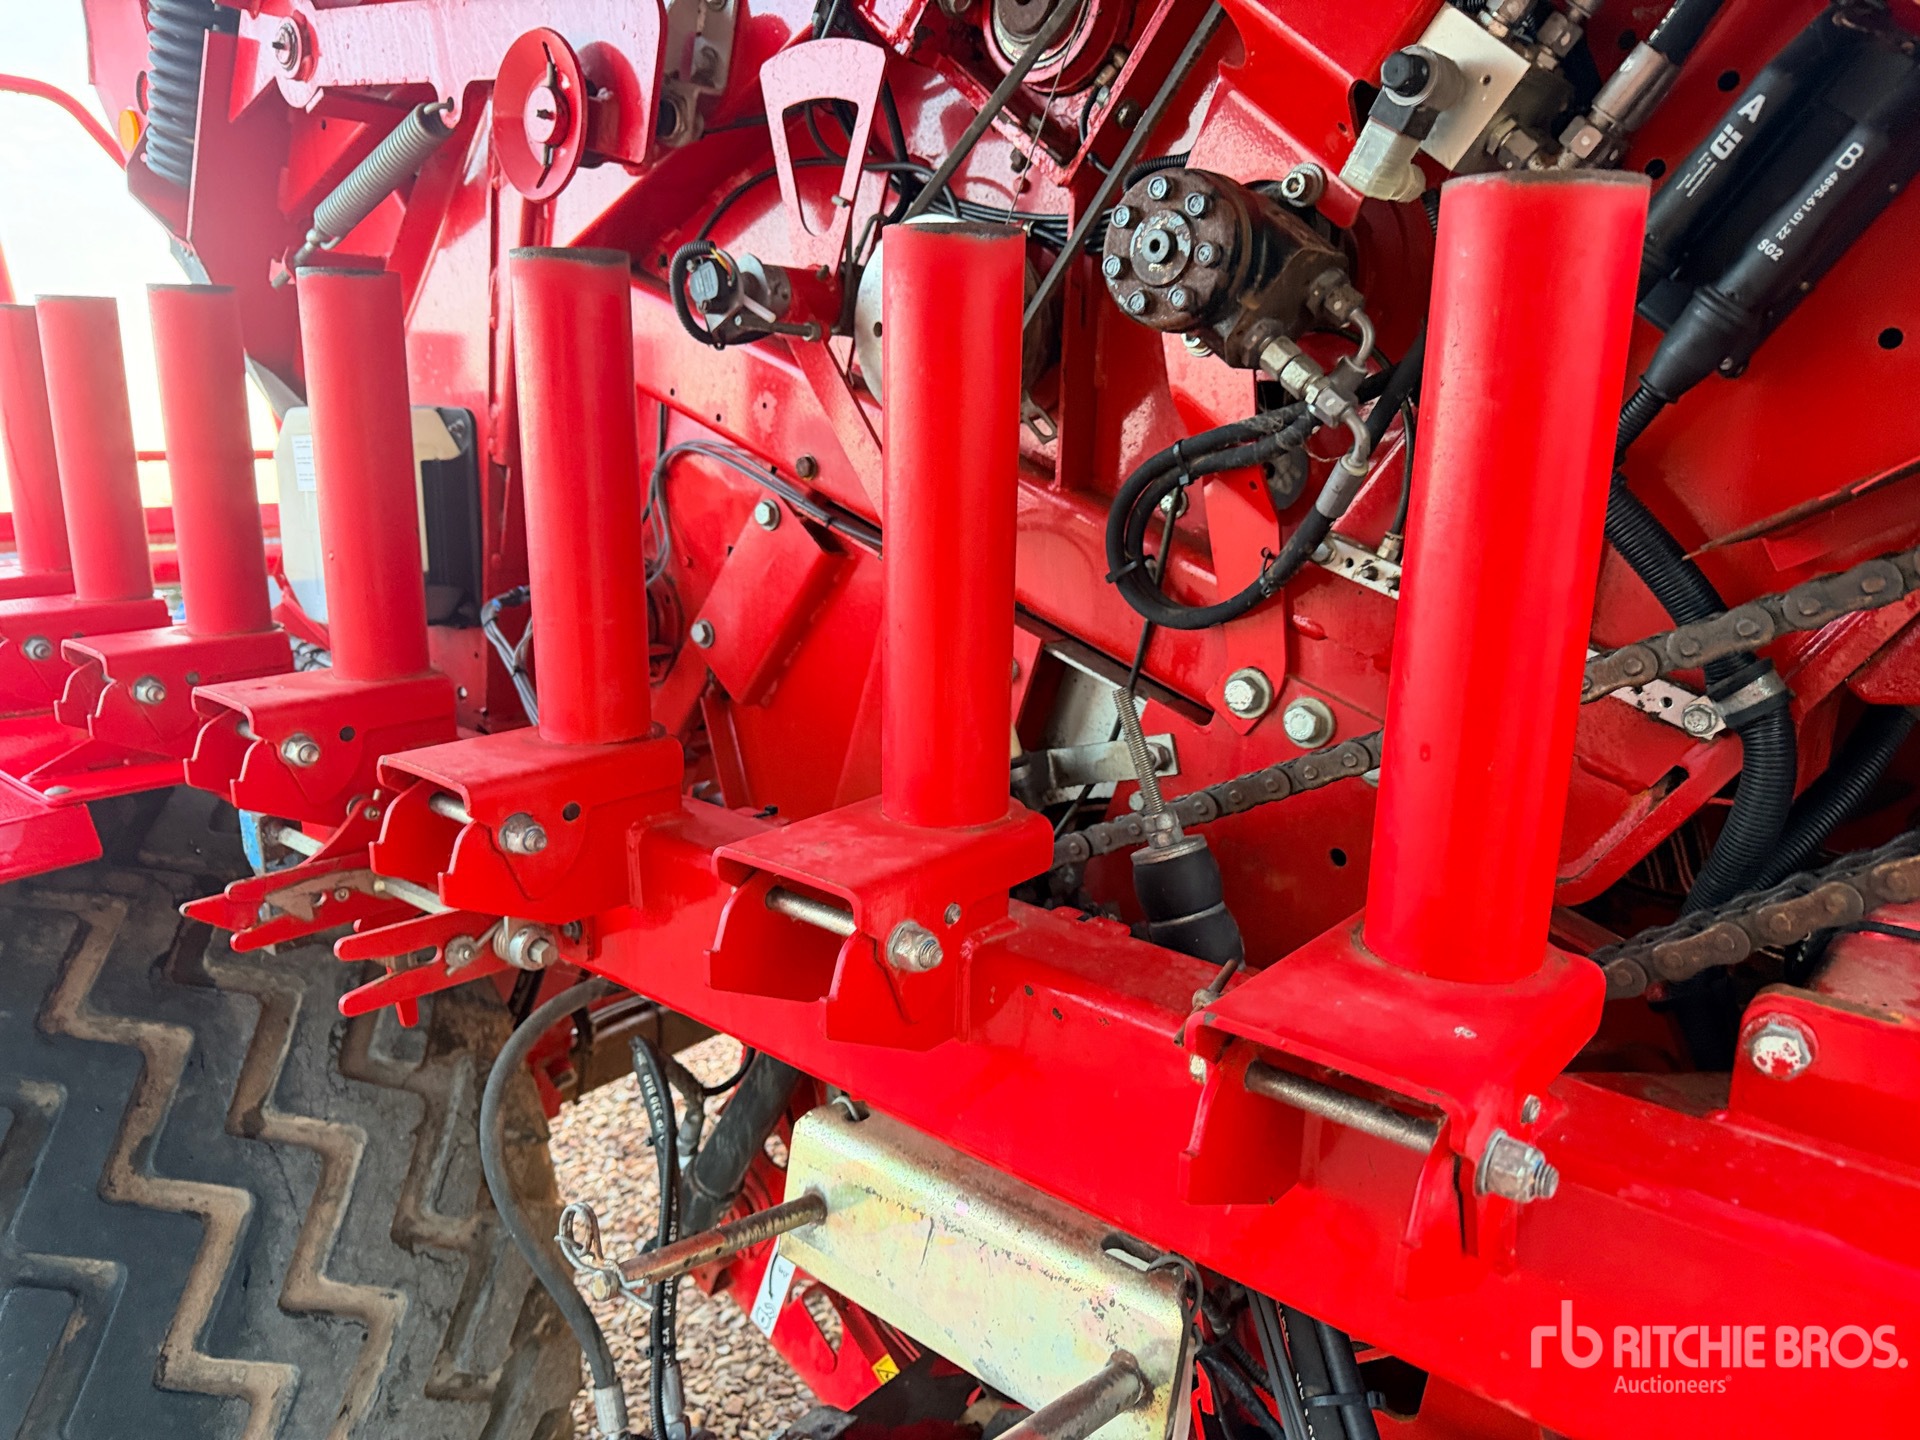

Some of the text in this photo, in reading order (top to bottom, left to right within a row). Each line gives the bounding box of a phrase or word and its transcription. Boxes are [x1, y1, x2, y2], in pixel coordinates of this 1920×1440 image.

[1738, 94, 1766, 123] A
[1835, 142, 1864, 171] B
[1775, 171, 1839, 241] 4895.61.01.22
[1757, 238, 1784, 261] SG2
[643, 1073, 657, 1095] BAR
